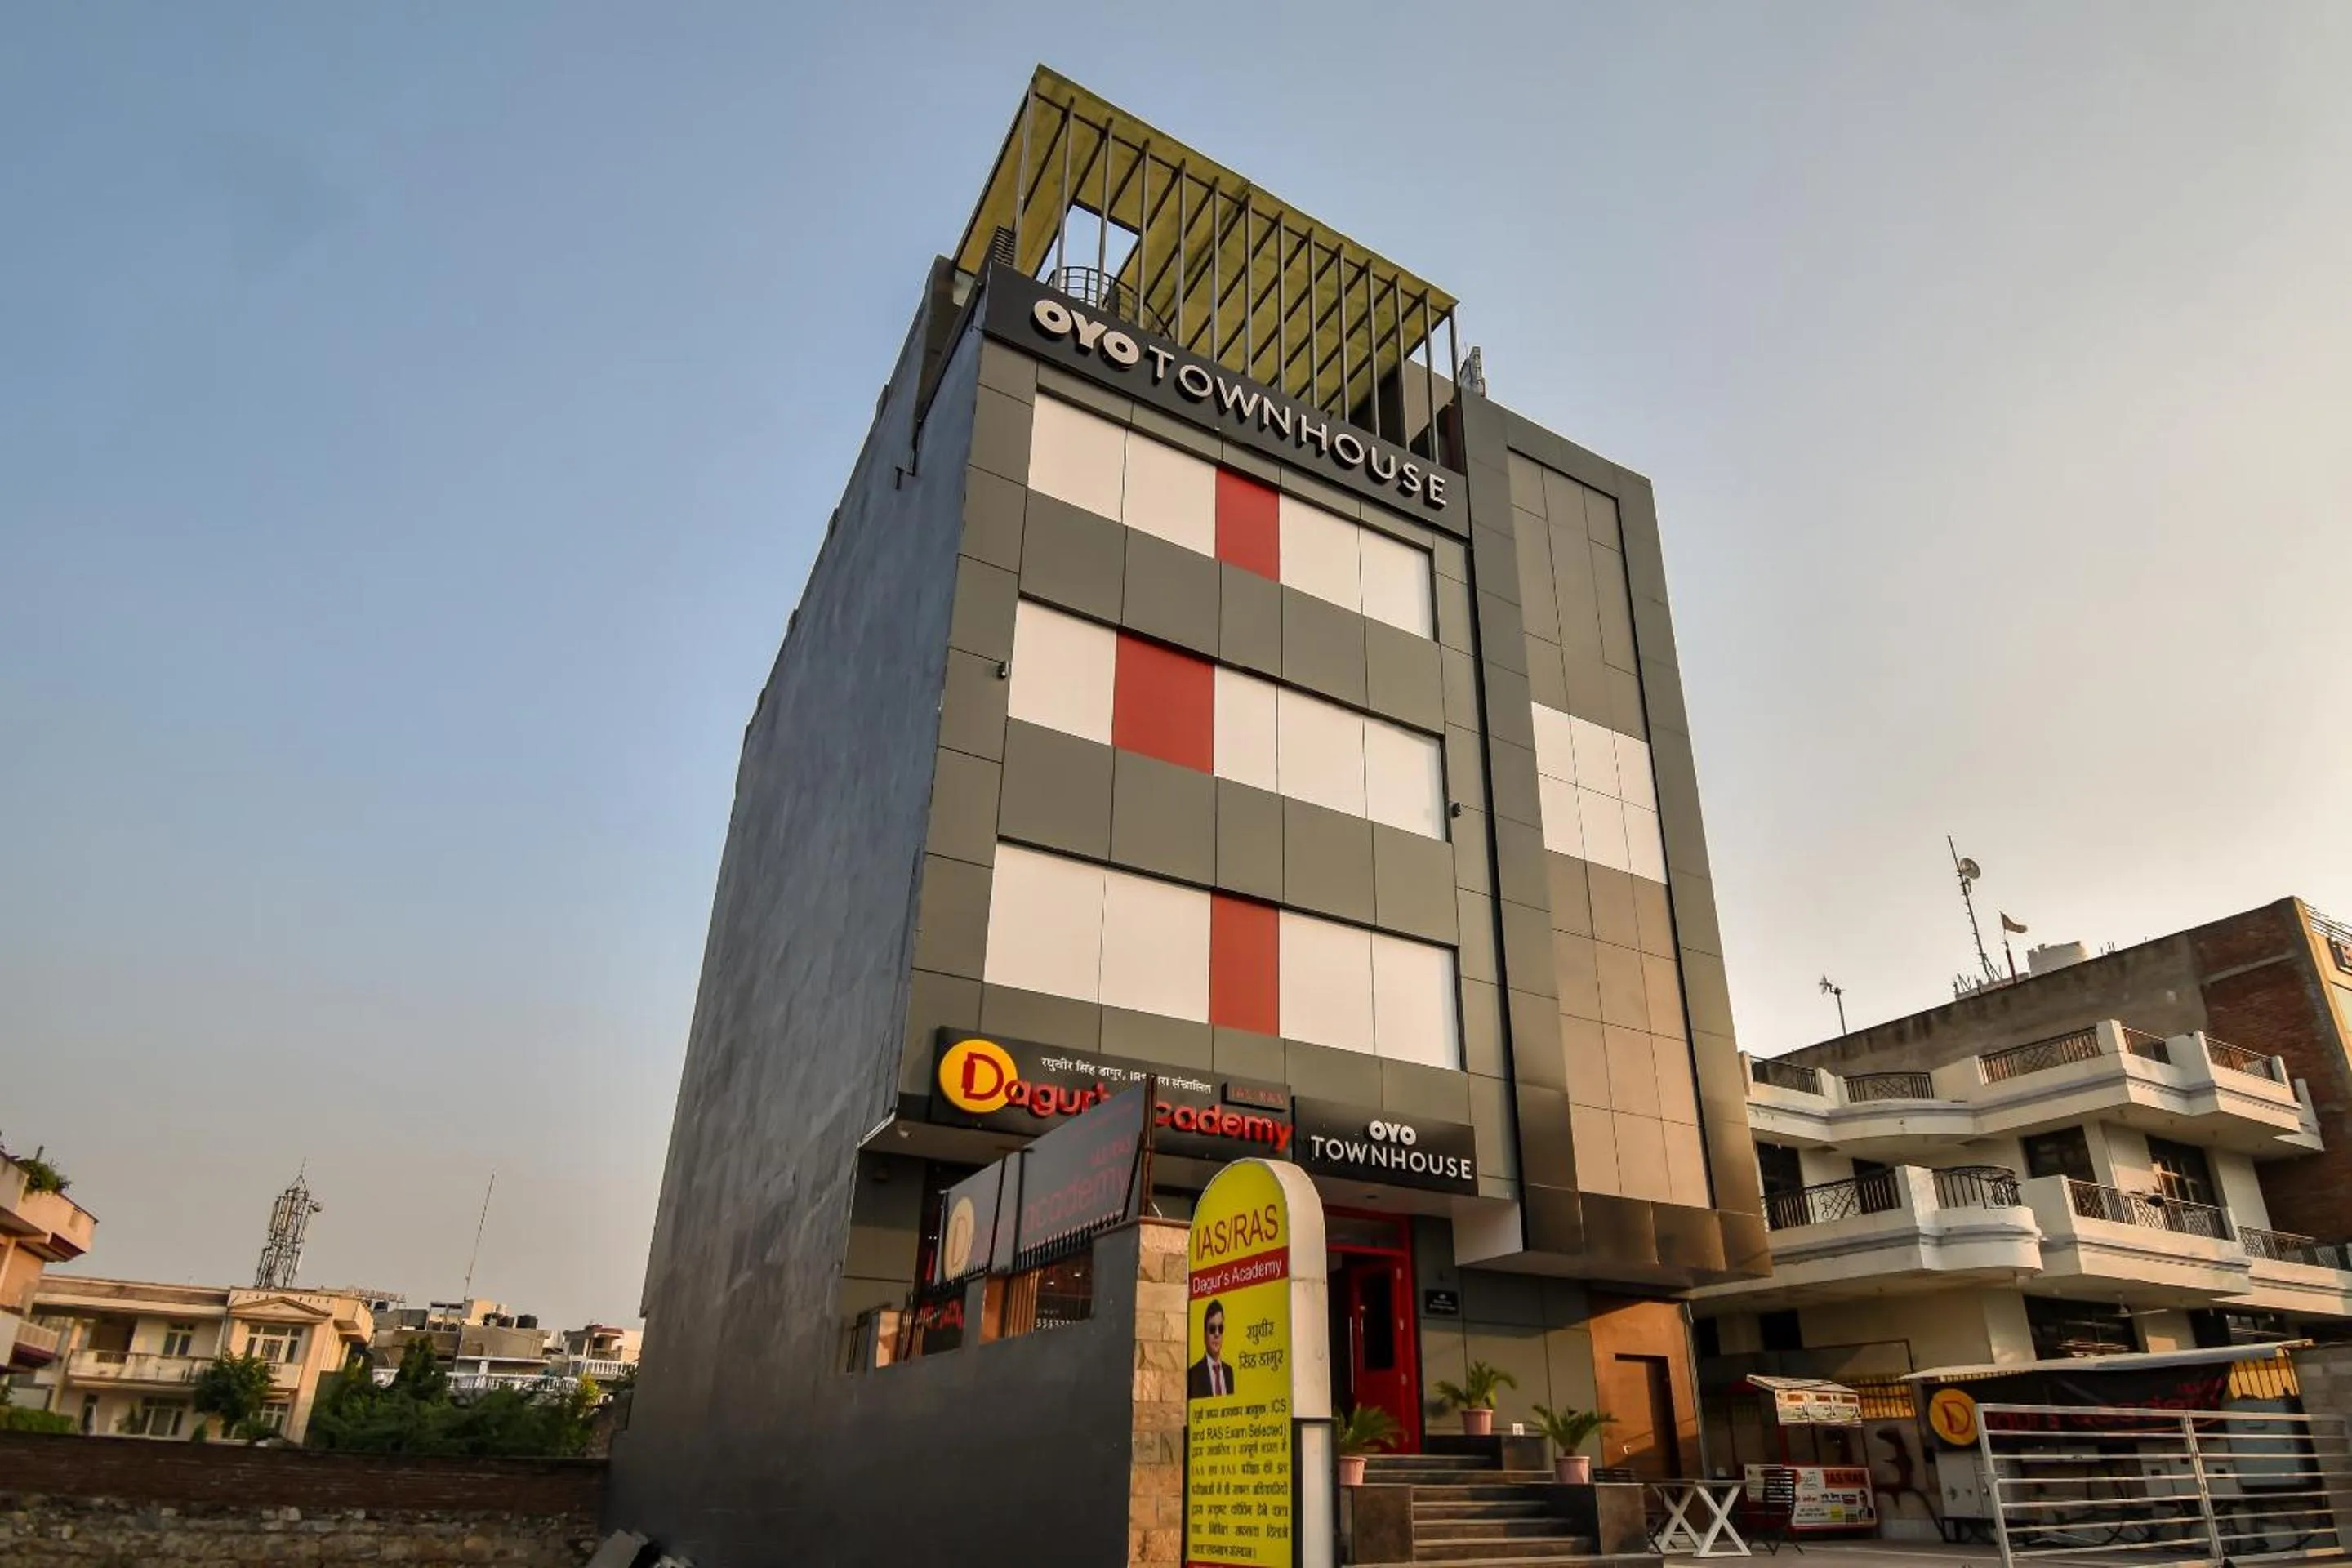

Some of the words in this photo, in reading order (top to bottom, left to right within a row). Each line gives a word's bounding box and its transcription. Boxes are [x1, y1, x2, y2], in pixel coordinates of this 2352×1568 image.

[1033, 299, 1140, 367] OYO
[1148, 344, 1449, 507] TOWNHOUSE
[1155, 1100, 1293, 1153] cademy
[1369, 1120, 1417, 1146] OYO
[1311, 1135, 1473, 1180] TOWNHOUSE
[1196, 1204, 1279, 1261] IAS/RAS
[1193, 1270, 1230, 1294] Dagur's
[1232, 1259, 1282, 1284] Academy
